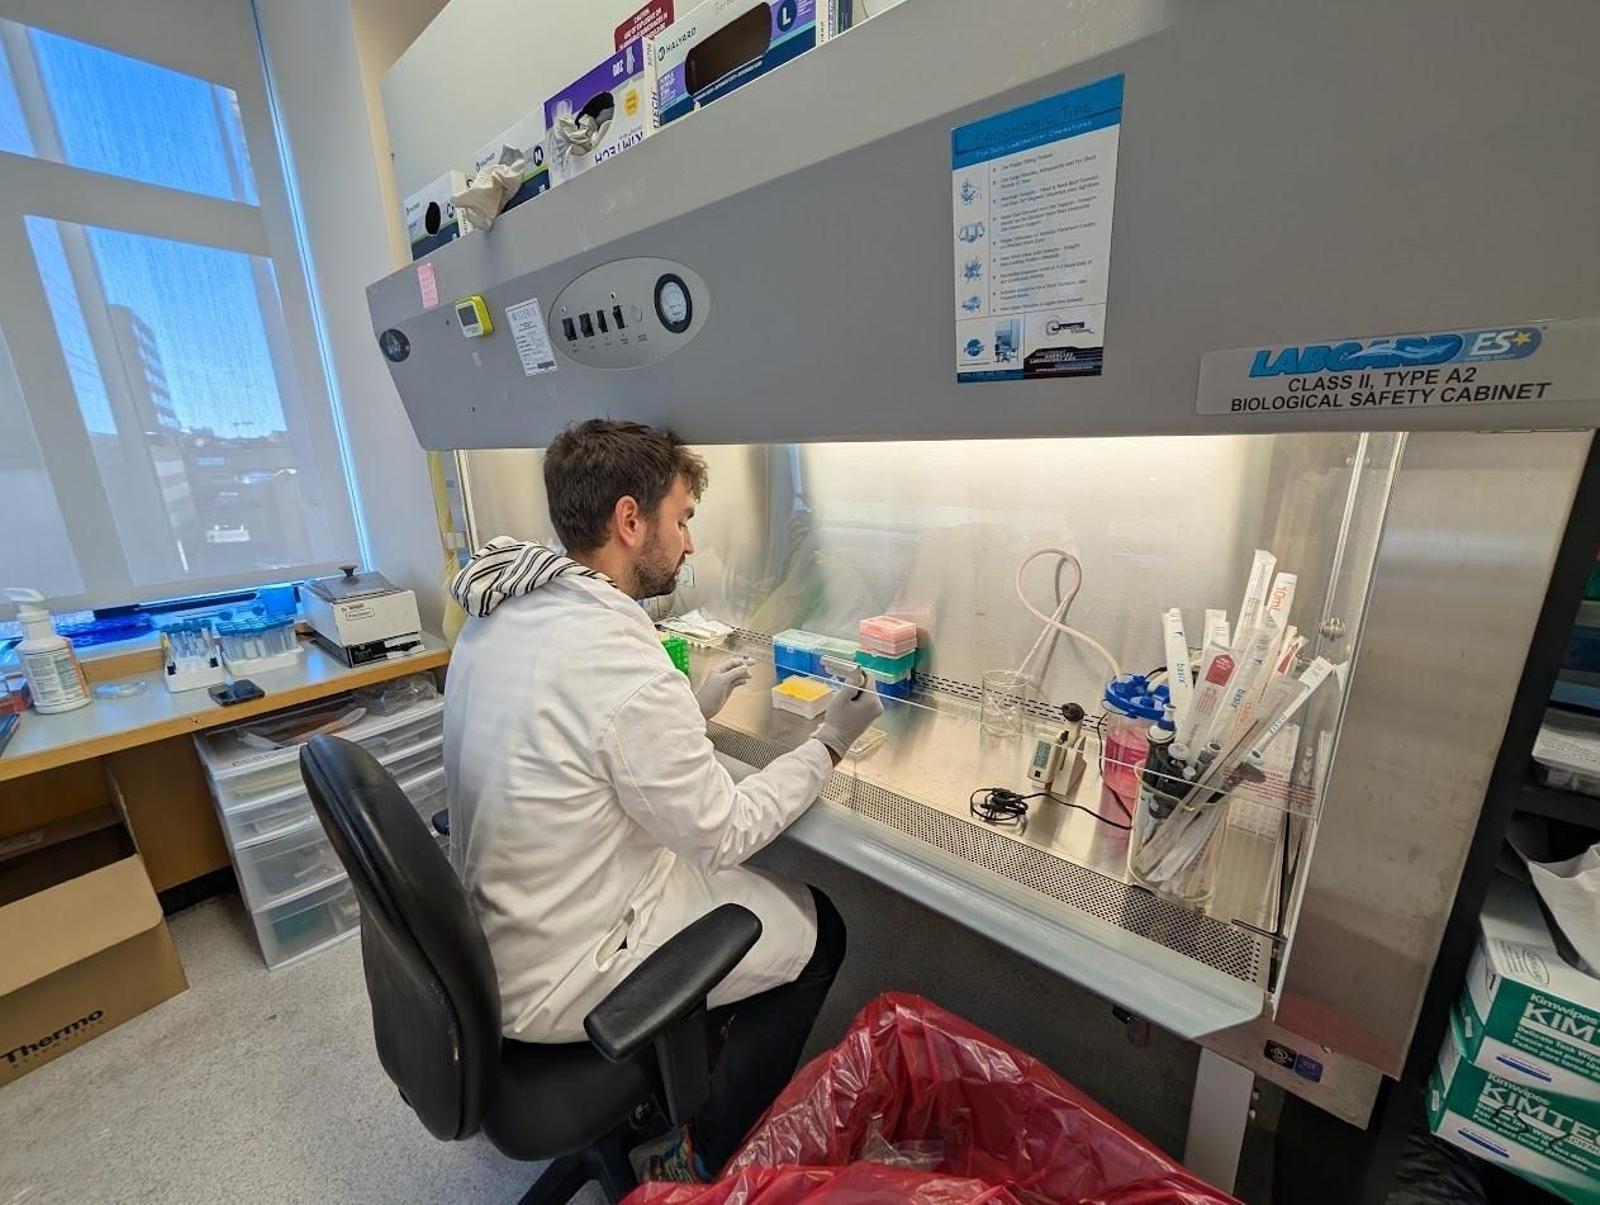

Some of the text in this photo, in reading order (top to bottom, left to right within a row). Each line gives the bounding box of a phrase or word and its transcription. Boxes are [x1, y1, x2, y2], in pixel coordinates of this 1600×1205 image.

[782, 9, 792, 26] L
[666, 27, 696, 53] HALYARD
[1248, 332, 1465, 378] LABGARD
[1288, 367, 1477, 392] CLASS II, TYPE A2
[1230, 382, 1552, 412] BIOLOGICAL SAFETY CABINET
[1523, 1001, 1600, 1042] KIM
[1530, 993, 1599, 1025] Kimwipes
[0, 1009, 104, 1064] Thermo
[1488, 1072, 1551, 1106] Kimwipes
[1482, 1080, 1600, 1144] KIMTE
